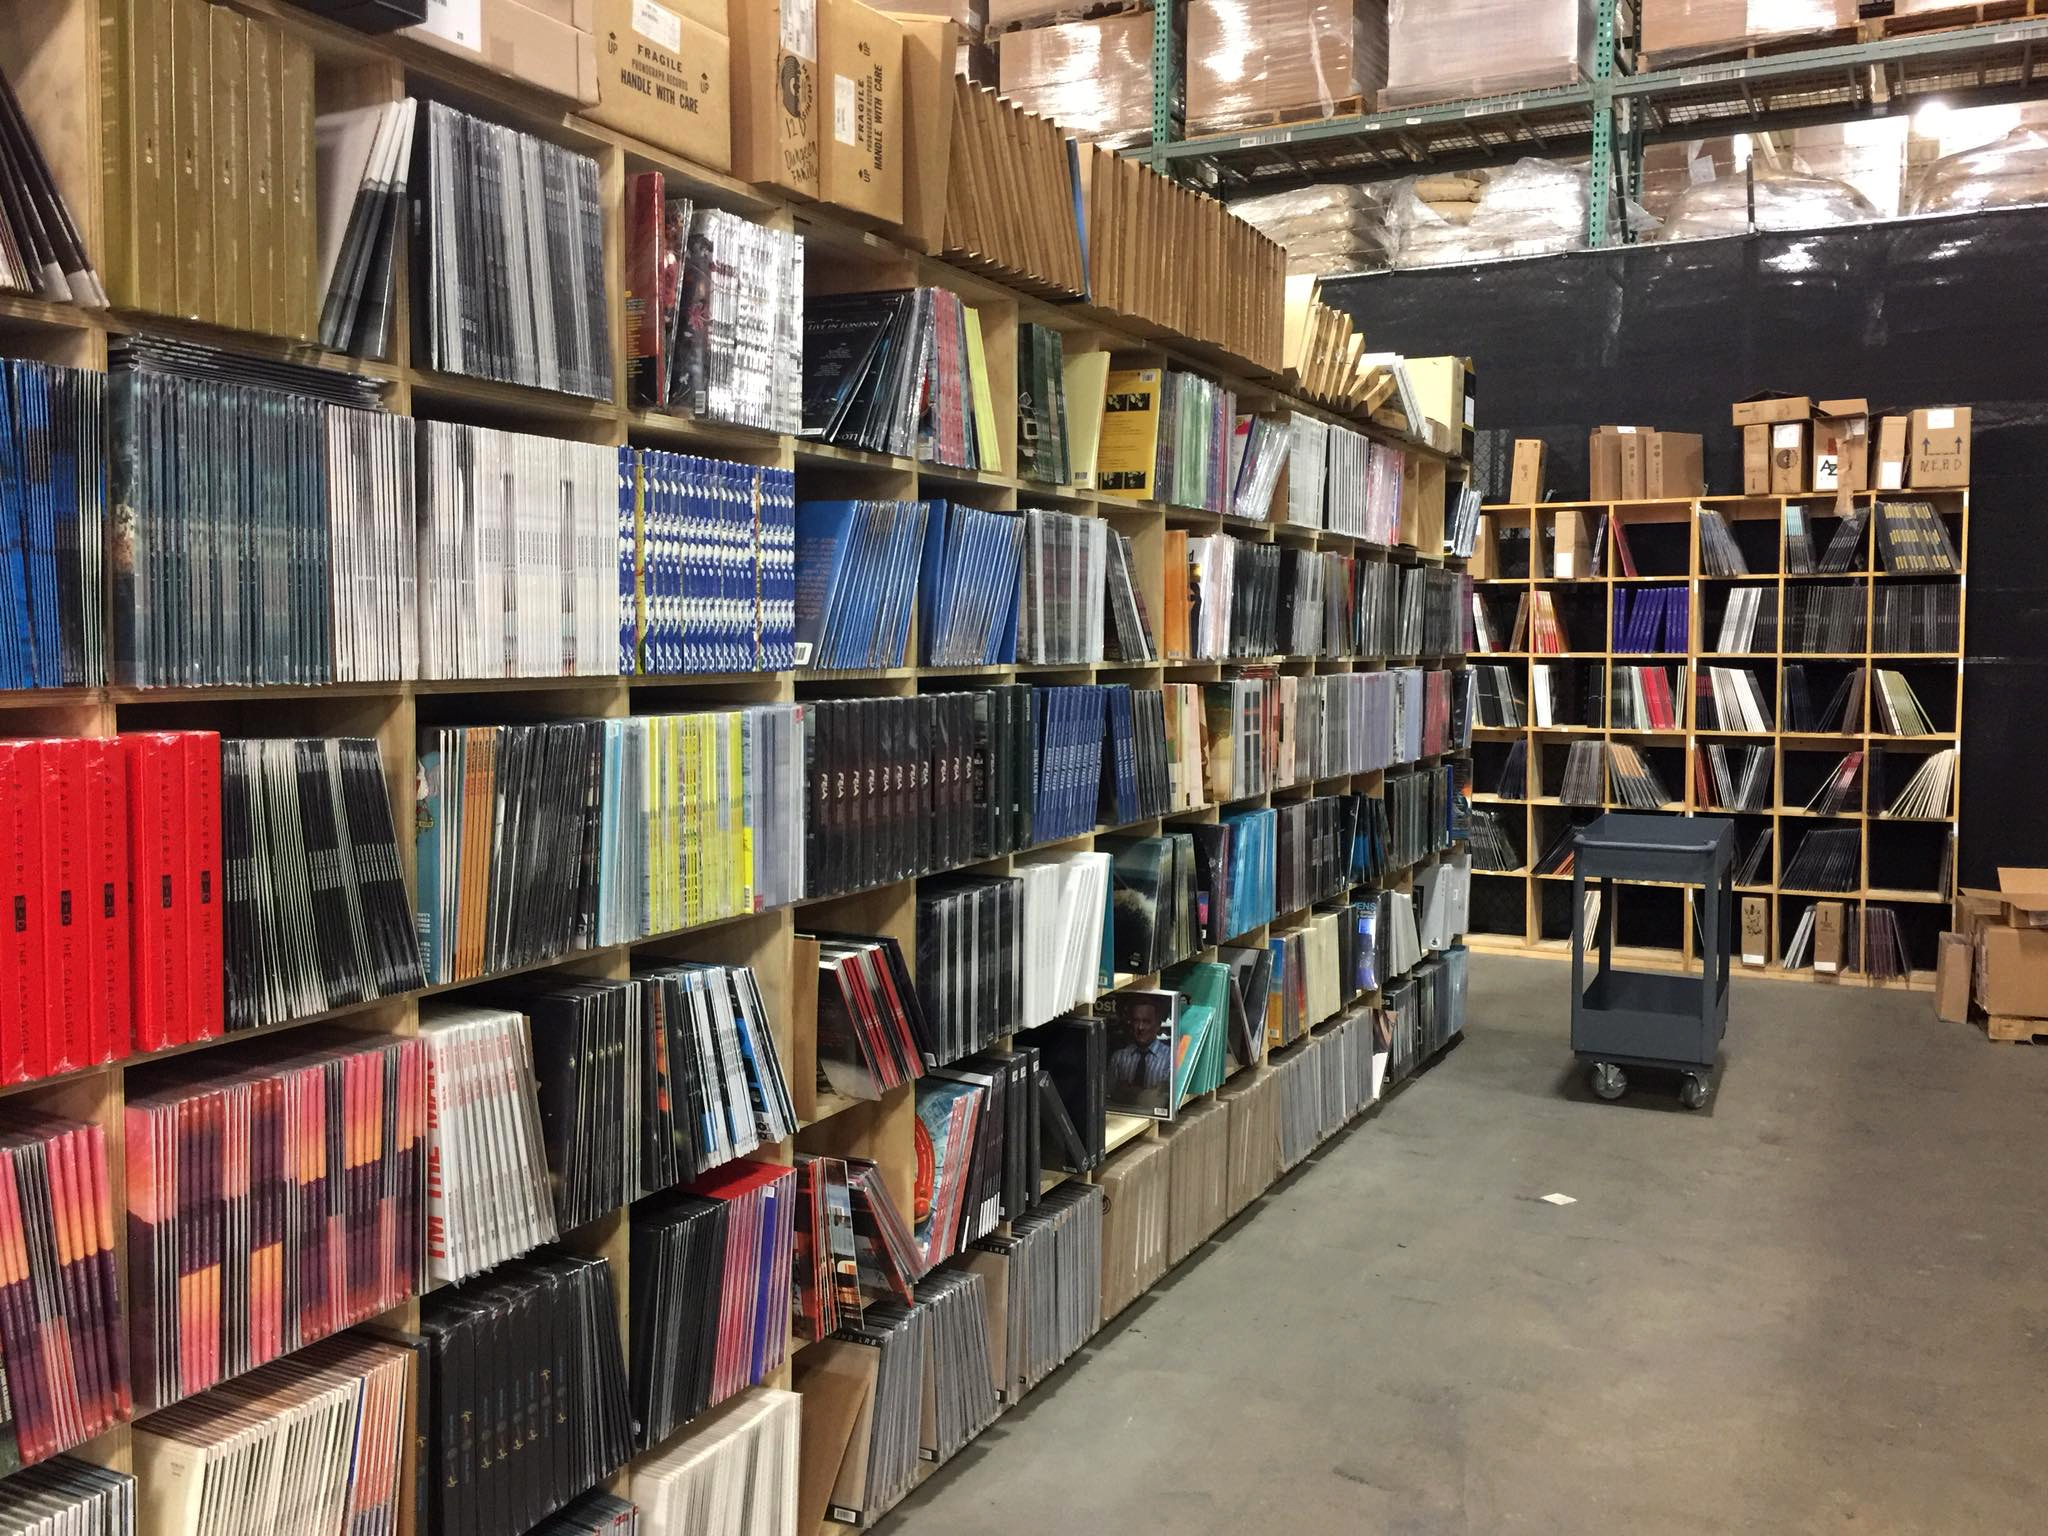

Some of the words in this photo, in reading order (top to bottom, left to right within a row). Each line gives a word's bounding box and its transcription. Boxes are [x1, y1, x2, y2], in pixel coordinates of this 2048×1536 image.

[607, 40, 618, 55] UP
[637, 43, 683, 73] FRAGILE
[863, 41, 871, 57] UP
[631, 58, 665, 82] PHONOGRAPH
[873, 63, 883, 93] CARE
[620, 67, 651, 96] HANDLE
[656, 83, 675, 105] WITH
[679, 93, 699, 114] CARE
[700, 81, 710, 94] UP
[857, 79, 865, 142] FRAGILE
[873, 97, 883, 124] WITH
[873, 129, 883, 171] HANDLE
[863, 168, 871, 183] UP
[840, 320, 880, 329] LONDON
